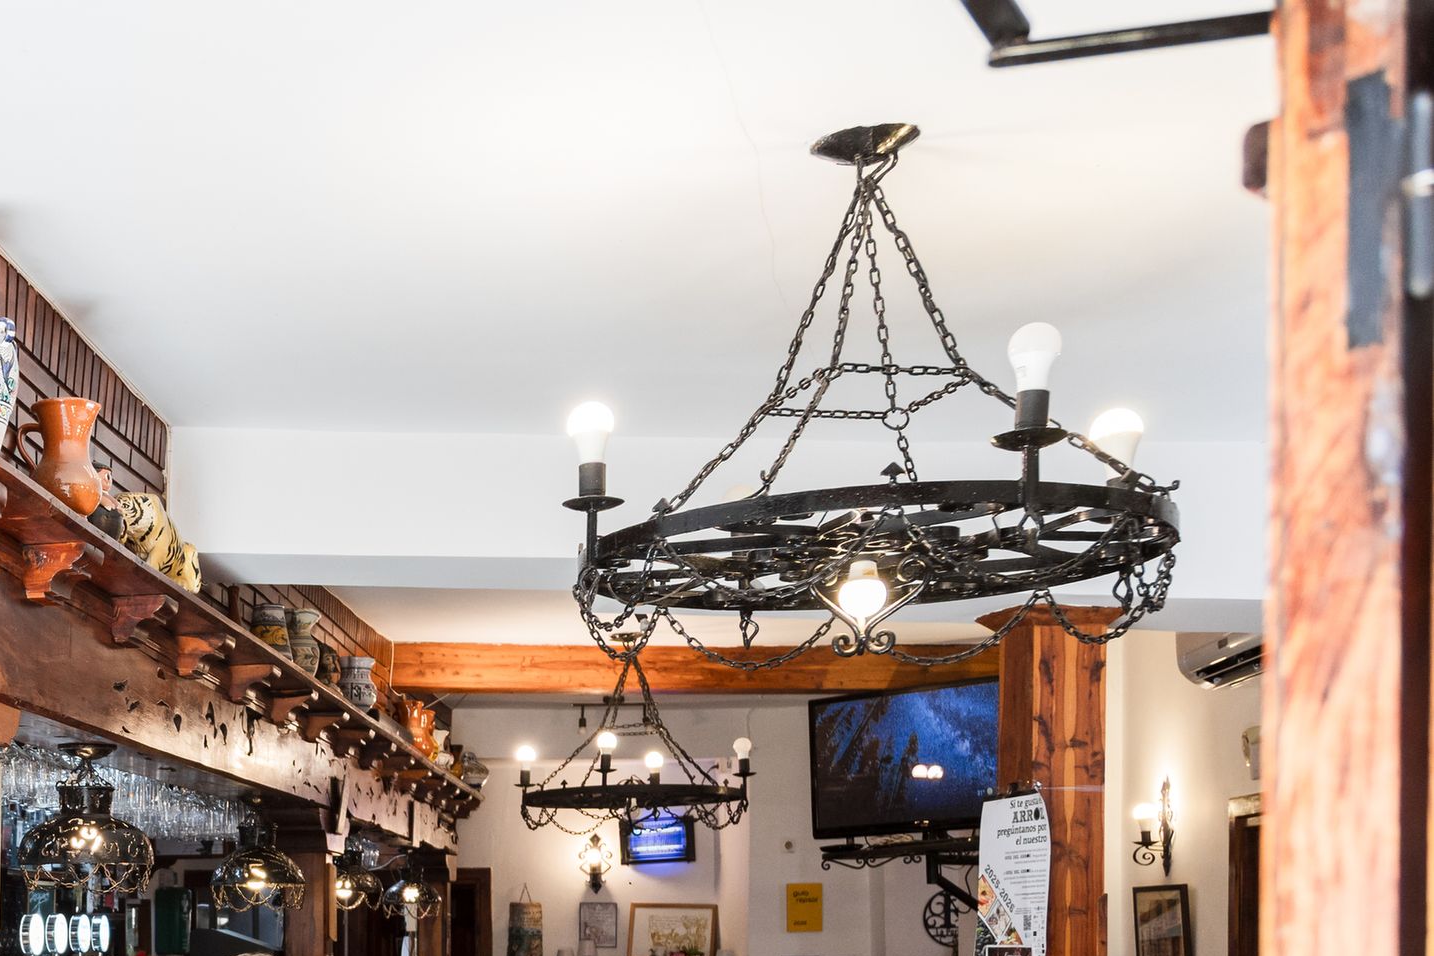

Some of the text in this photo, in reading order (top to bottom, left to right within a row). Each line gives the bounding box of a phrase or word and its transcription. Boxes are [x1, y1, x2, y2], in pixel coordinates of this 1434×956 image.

[1017, 800, 1023, 808] te
[997, 824, 1036, 839] pregúntanos
[1015, 835, 1047, 845] el nuestro
